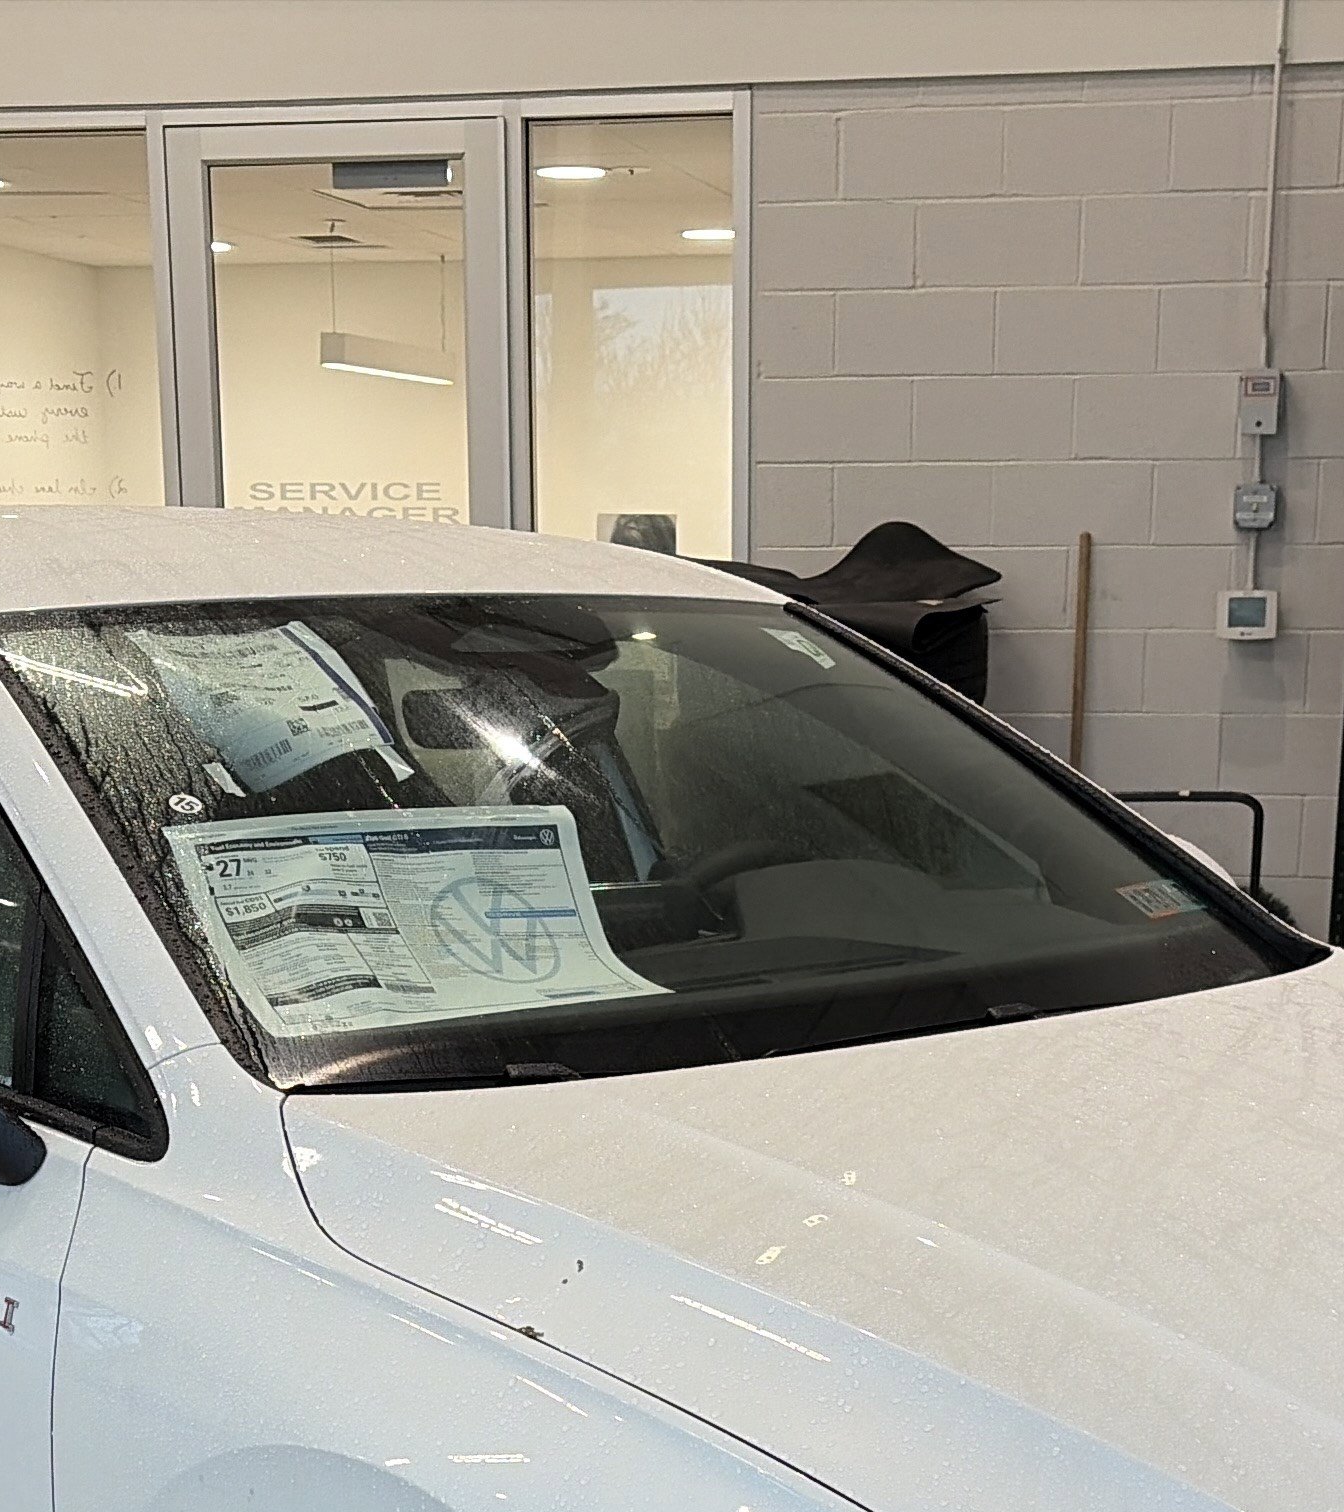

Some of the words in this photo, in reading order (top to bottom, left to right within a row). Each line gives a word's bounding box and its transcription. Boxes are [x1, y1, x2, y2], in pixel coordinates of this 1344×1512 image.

[248, 481, 442, 502] SERVICE
[173, 796, 200, 812] 15
[216, 858, 241, 878] 27
[224, 902, 267, 917] $1,850
